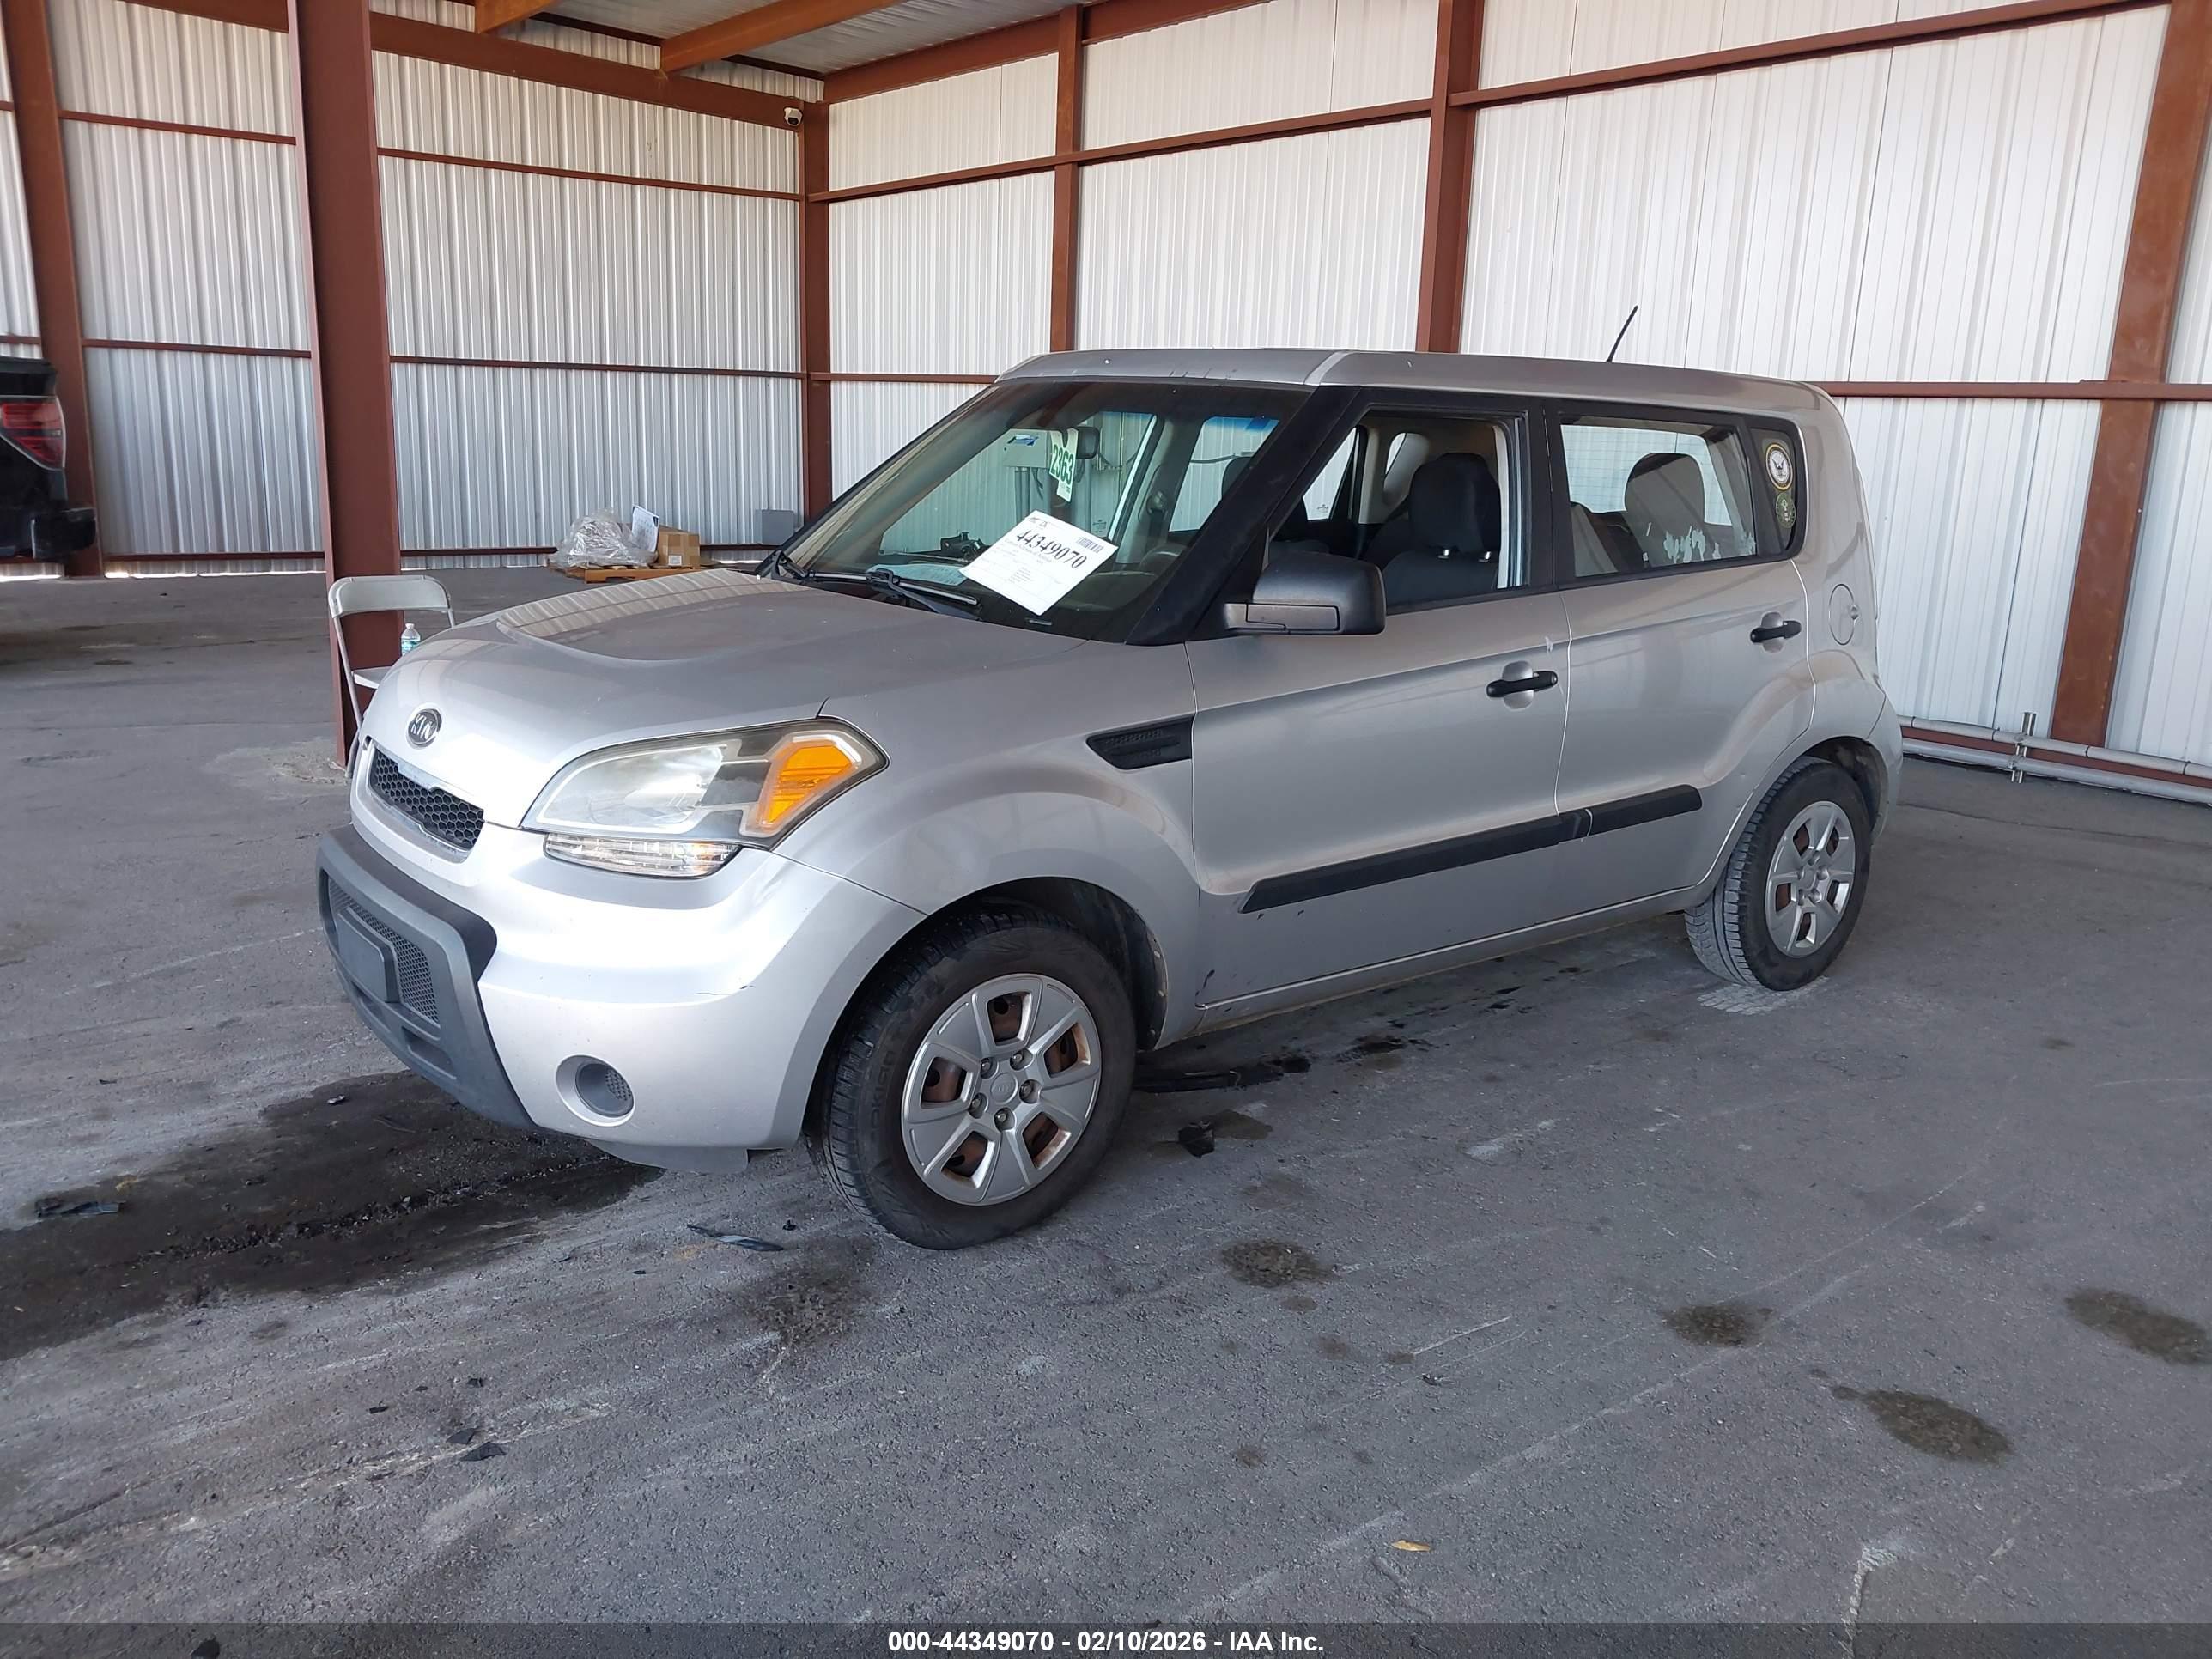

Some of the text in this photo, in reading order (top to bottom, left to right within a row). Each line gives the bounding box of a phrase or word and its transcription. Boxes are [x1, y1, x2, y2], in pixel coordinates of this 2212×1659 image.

[1051, 444, 1073, 485] 2363
[1017, 530, 1087, 568] 44349070
[410, 713, 434, 740] KIA
